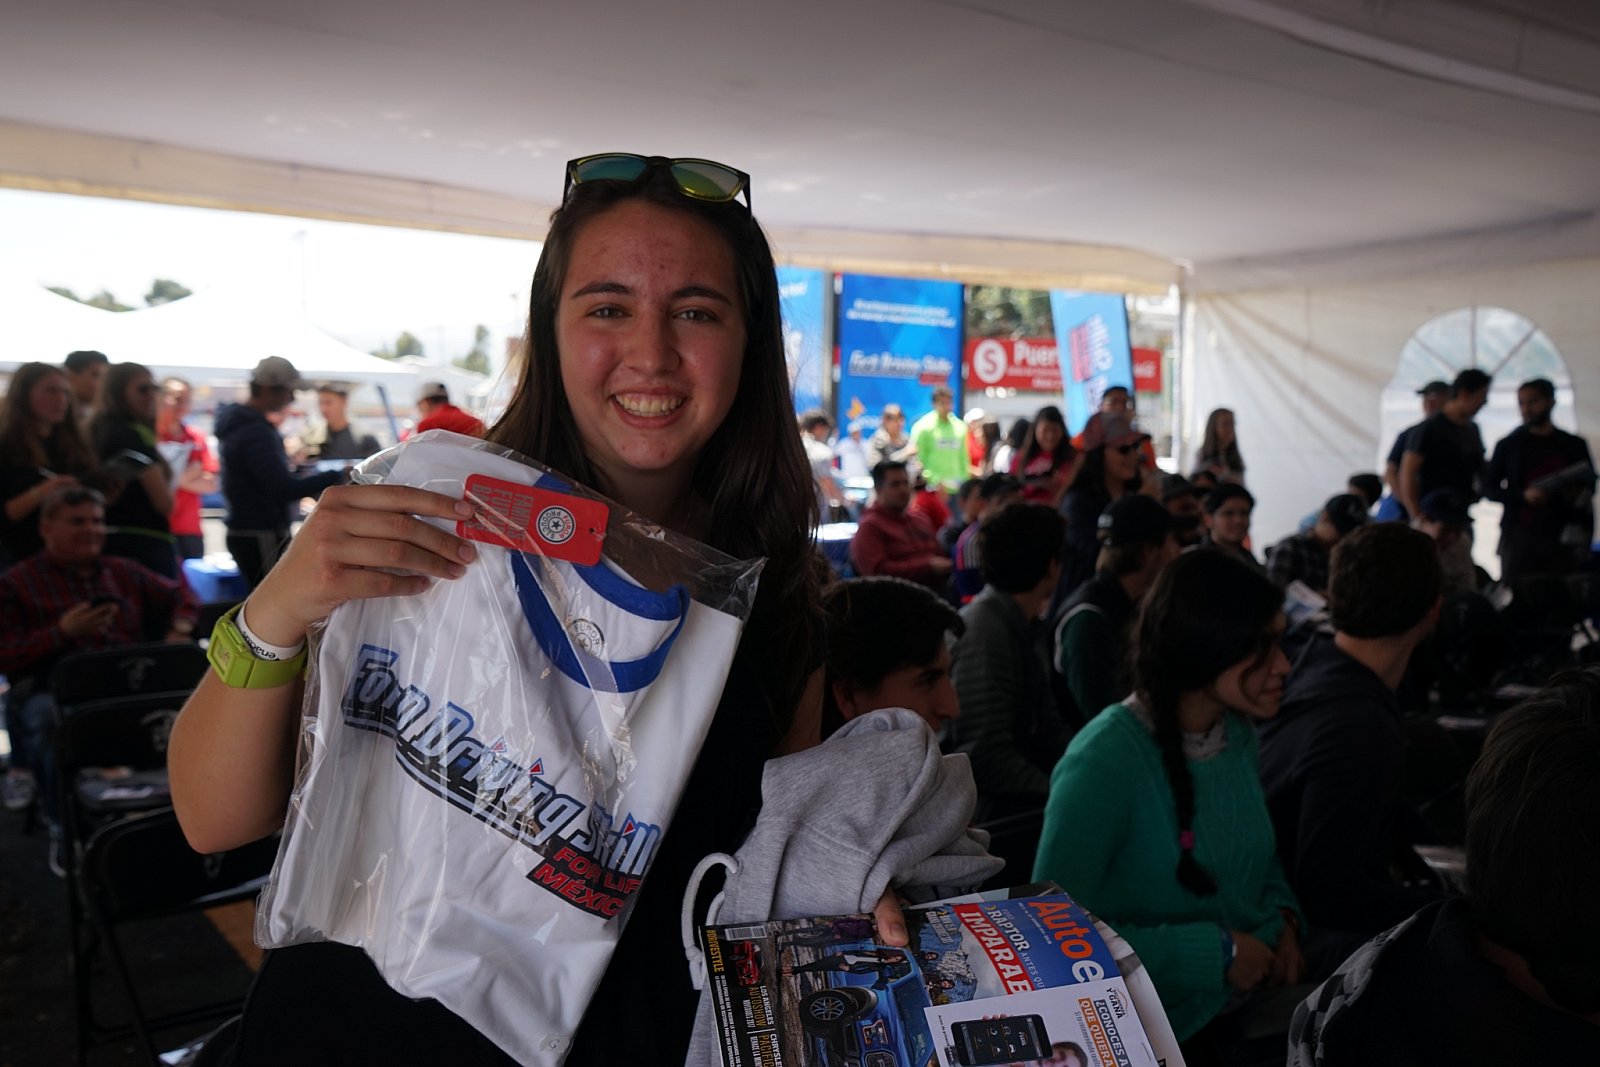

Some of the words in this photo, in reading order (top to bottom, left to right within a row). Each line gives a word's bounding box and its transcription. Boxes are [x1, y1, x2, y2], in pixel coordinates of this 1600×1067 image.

[559, 515, 572, 539] FUROR
[410, 700, 586, 847] Driving
[553, 848, 603, 884] FOR
[988, 910, 1030, 951] RAPTOR
[1021, 952, 1038, 976] ANTES
[748, 986, 767, 1027] AUTOSHOW
[760, 985, 768, 996] LOS
[1109, 995, 1124, 1019] GANA
[763, 997, 774, 1025] ANGELES
[1081, 1001, 1096, 1023] QUE
[1096, 1001, 1124, 1056] ¿CONOCES
[770, 1033, 782, 1067] CHRYSLE
